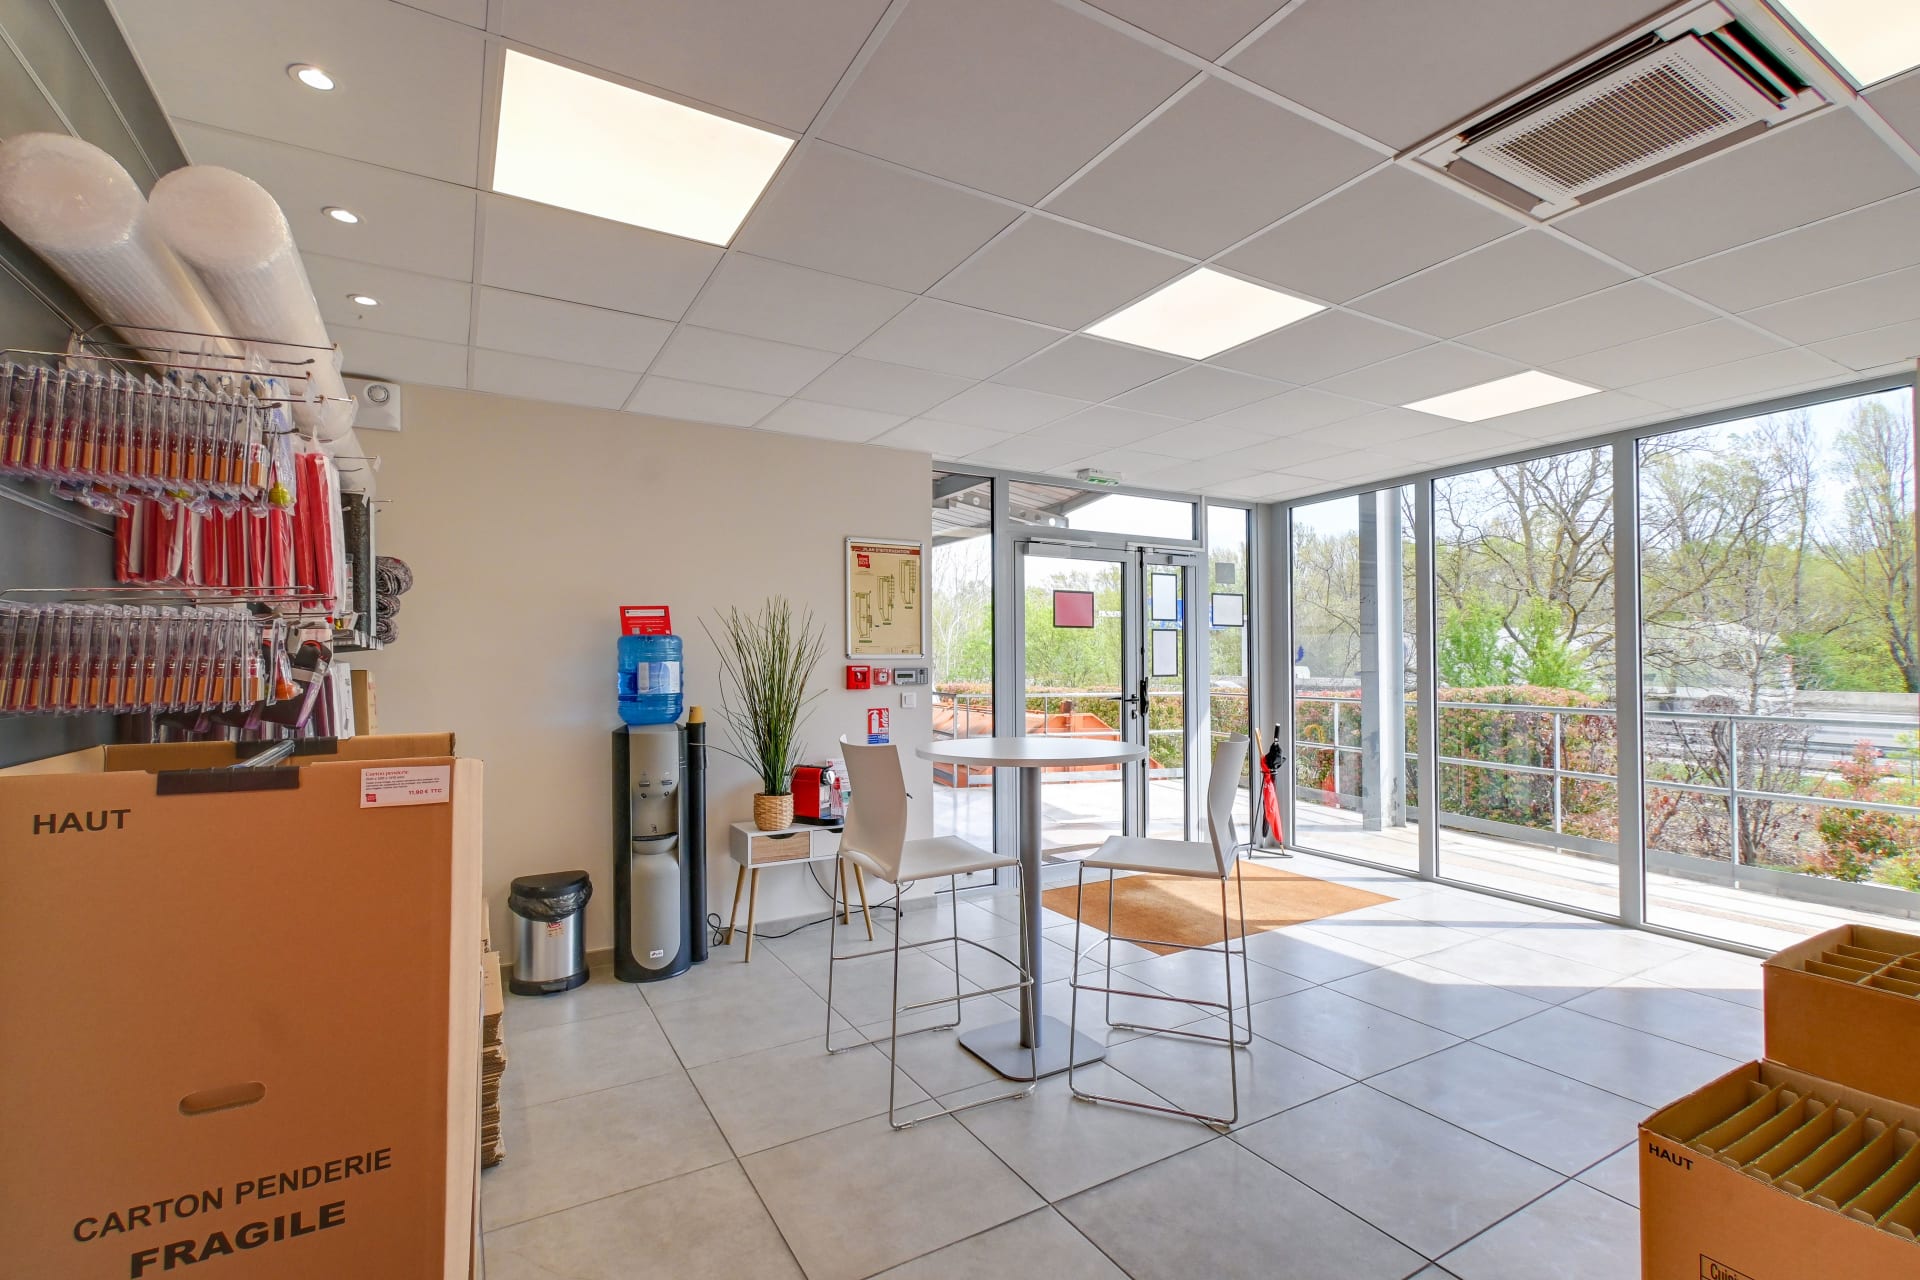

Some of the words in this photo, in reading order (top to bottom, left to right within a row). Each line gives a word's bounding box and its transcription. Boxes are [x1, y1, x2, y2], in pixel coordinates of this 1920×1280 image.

[33, 809, 132, 835] HAUT
[1649, 1143, 1694, 1171] HAUT
[73, 1187, 223, 1243] CARTON
[235, 1148, 392, 1205] PENDERIE
[130, 1200, 346, 1280] FRAGILE
